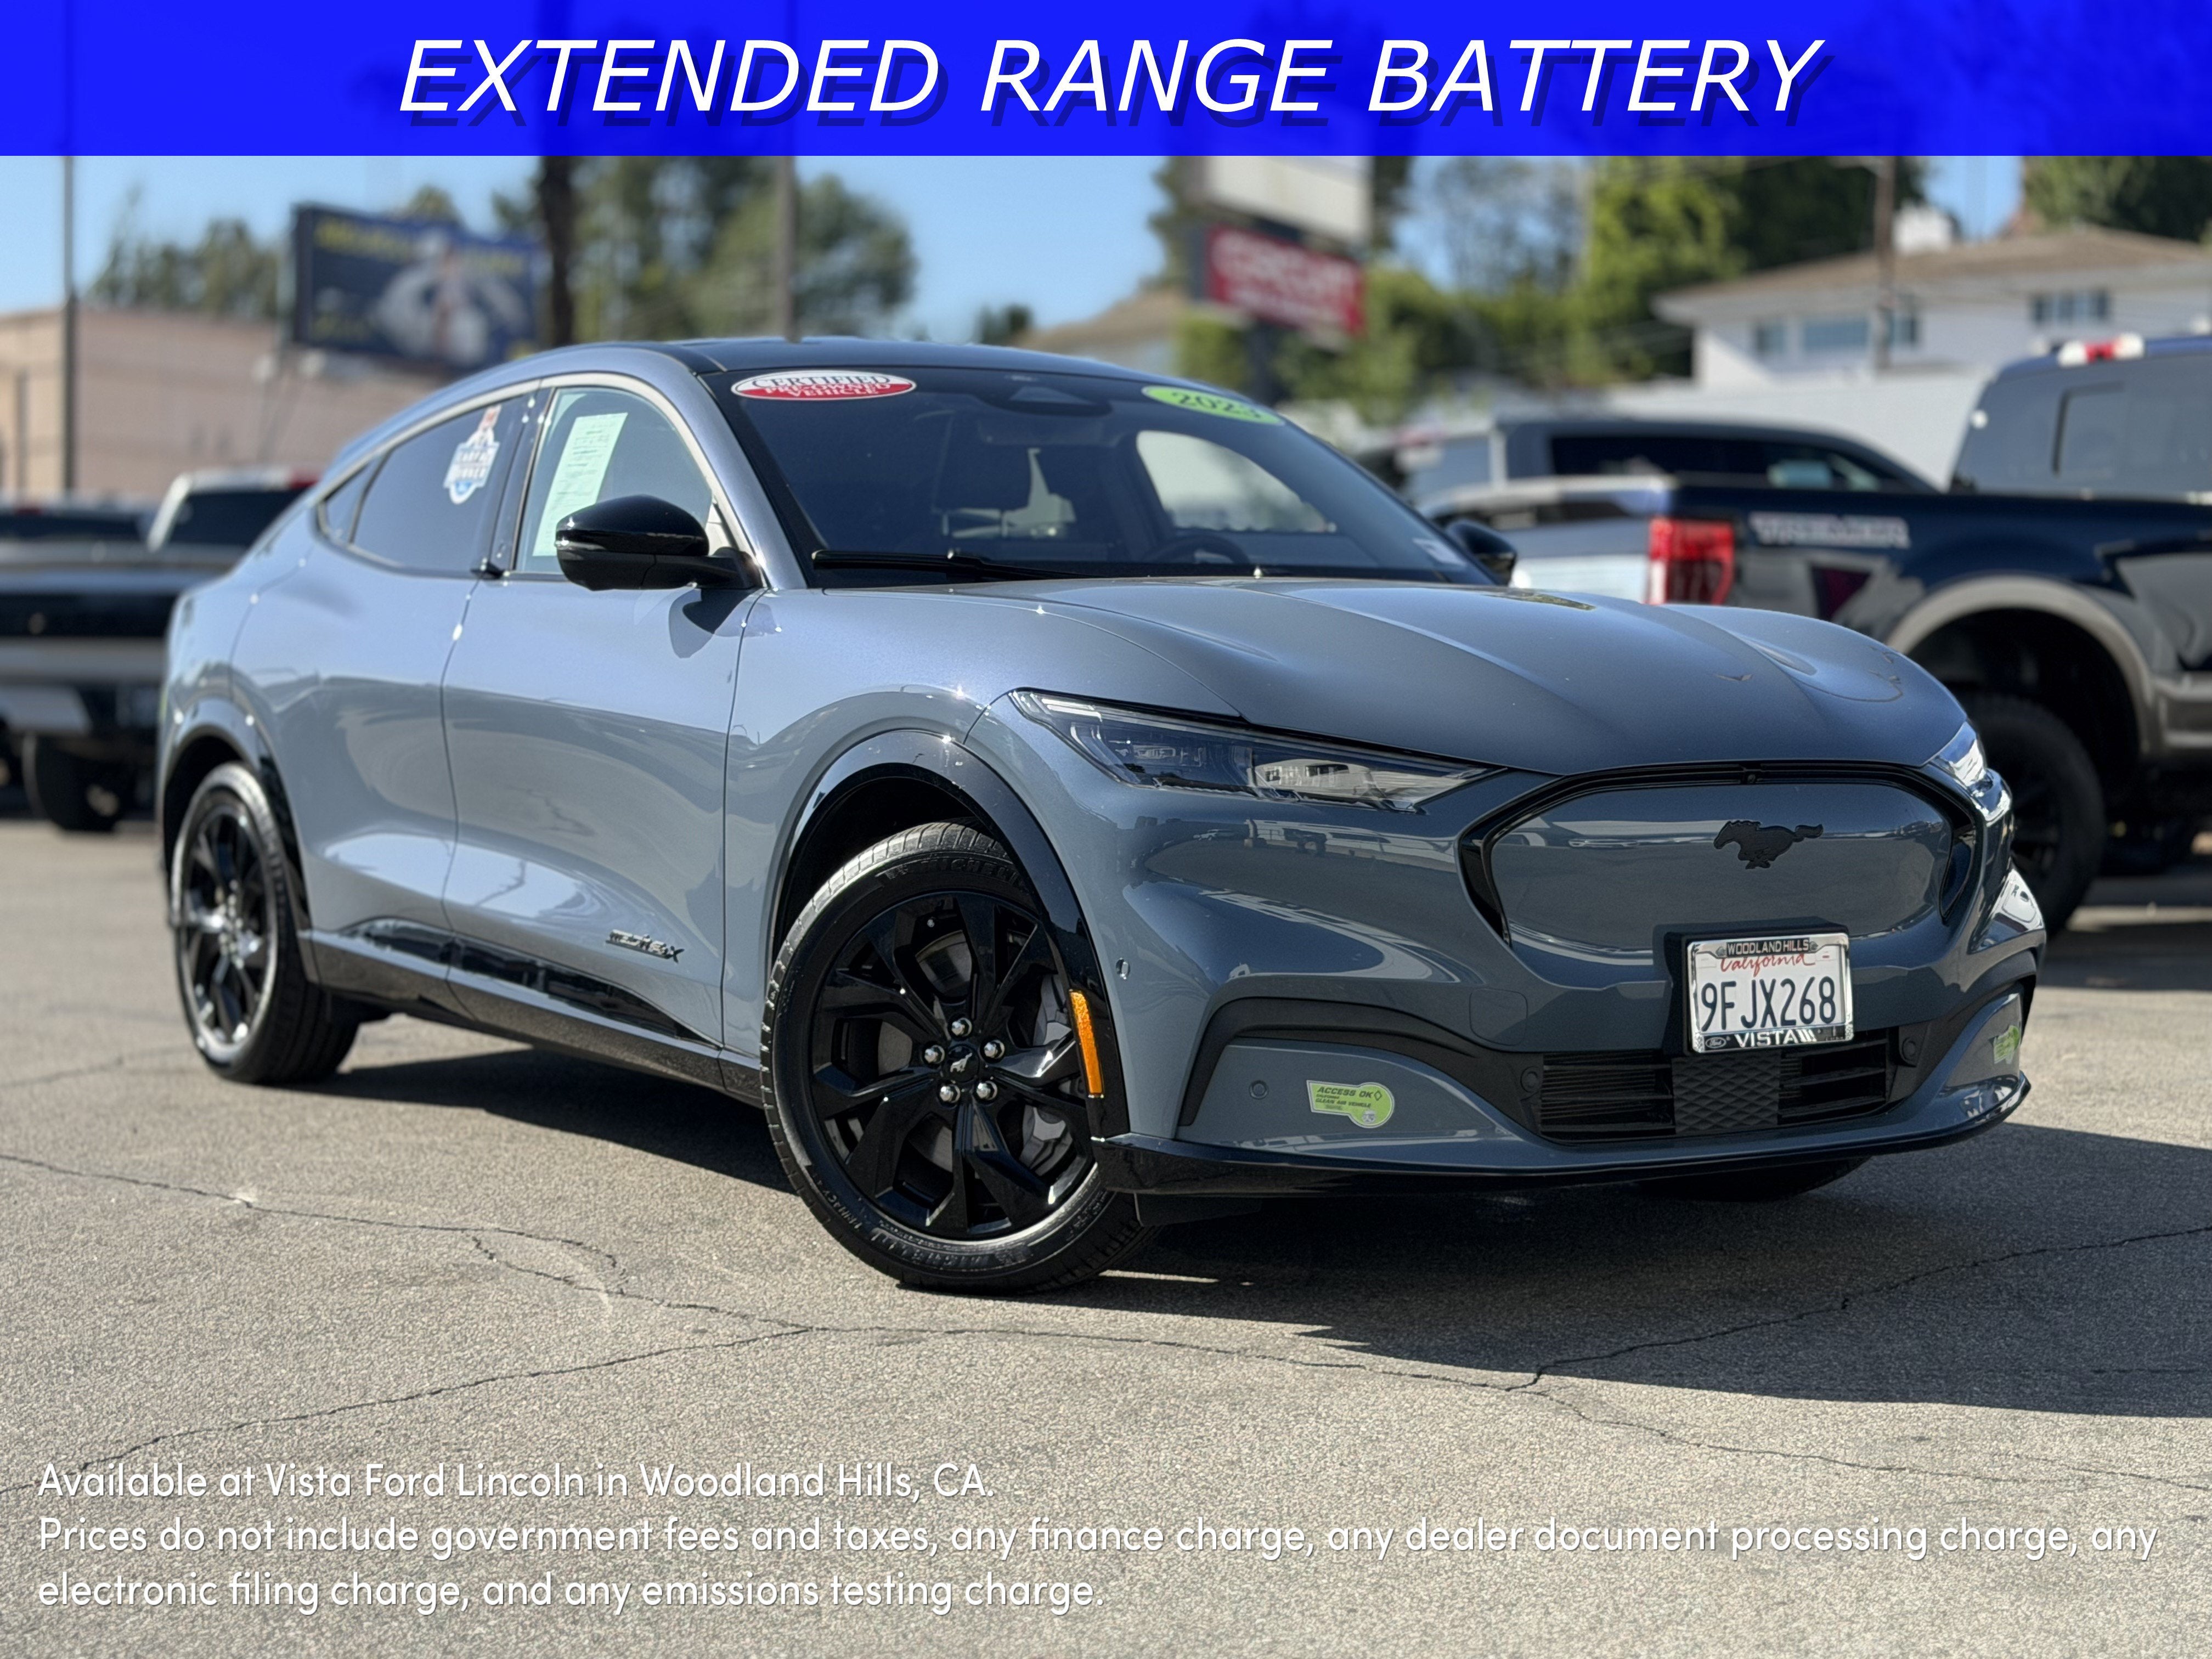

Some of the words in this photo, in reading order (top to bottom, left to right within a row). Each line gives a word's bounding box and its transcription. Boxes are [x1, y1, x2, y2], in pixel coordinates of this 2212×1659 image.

[752, 375, 890, 388] CERTIFIED
[787, 389, 879, 397] VEHICLE
[1728, 943, 1782, 955] WOODLAND
[1783, 939, 1809, 952] HILLS
[1720, 953, 1816, 978] California
[1700, 976, 1836, 1032] 9FJX268
[1734, 1031, 1798, 1048] VISTA
[1317, 1086, 1356, 1097] ACCESS
[1358, 1091, 1374, 1099] OK
